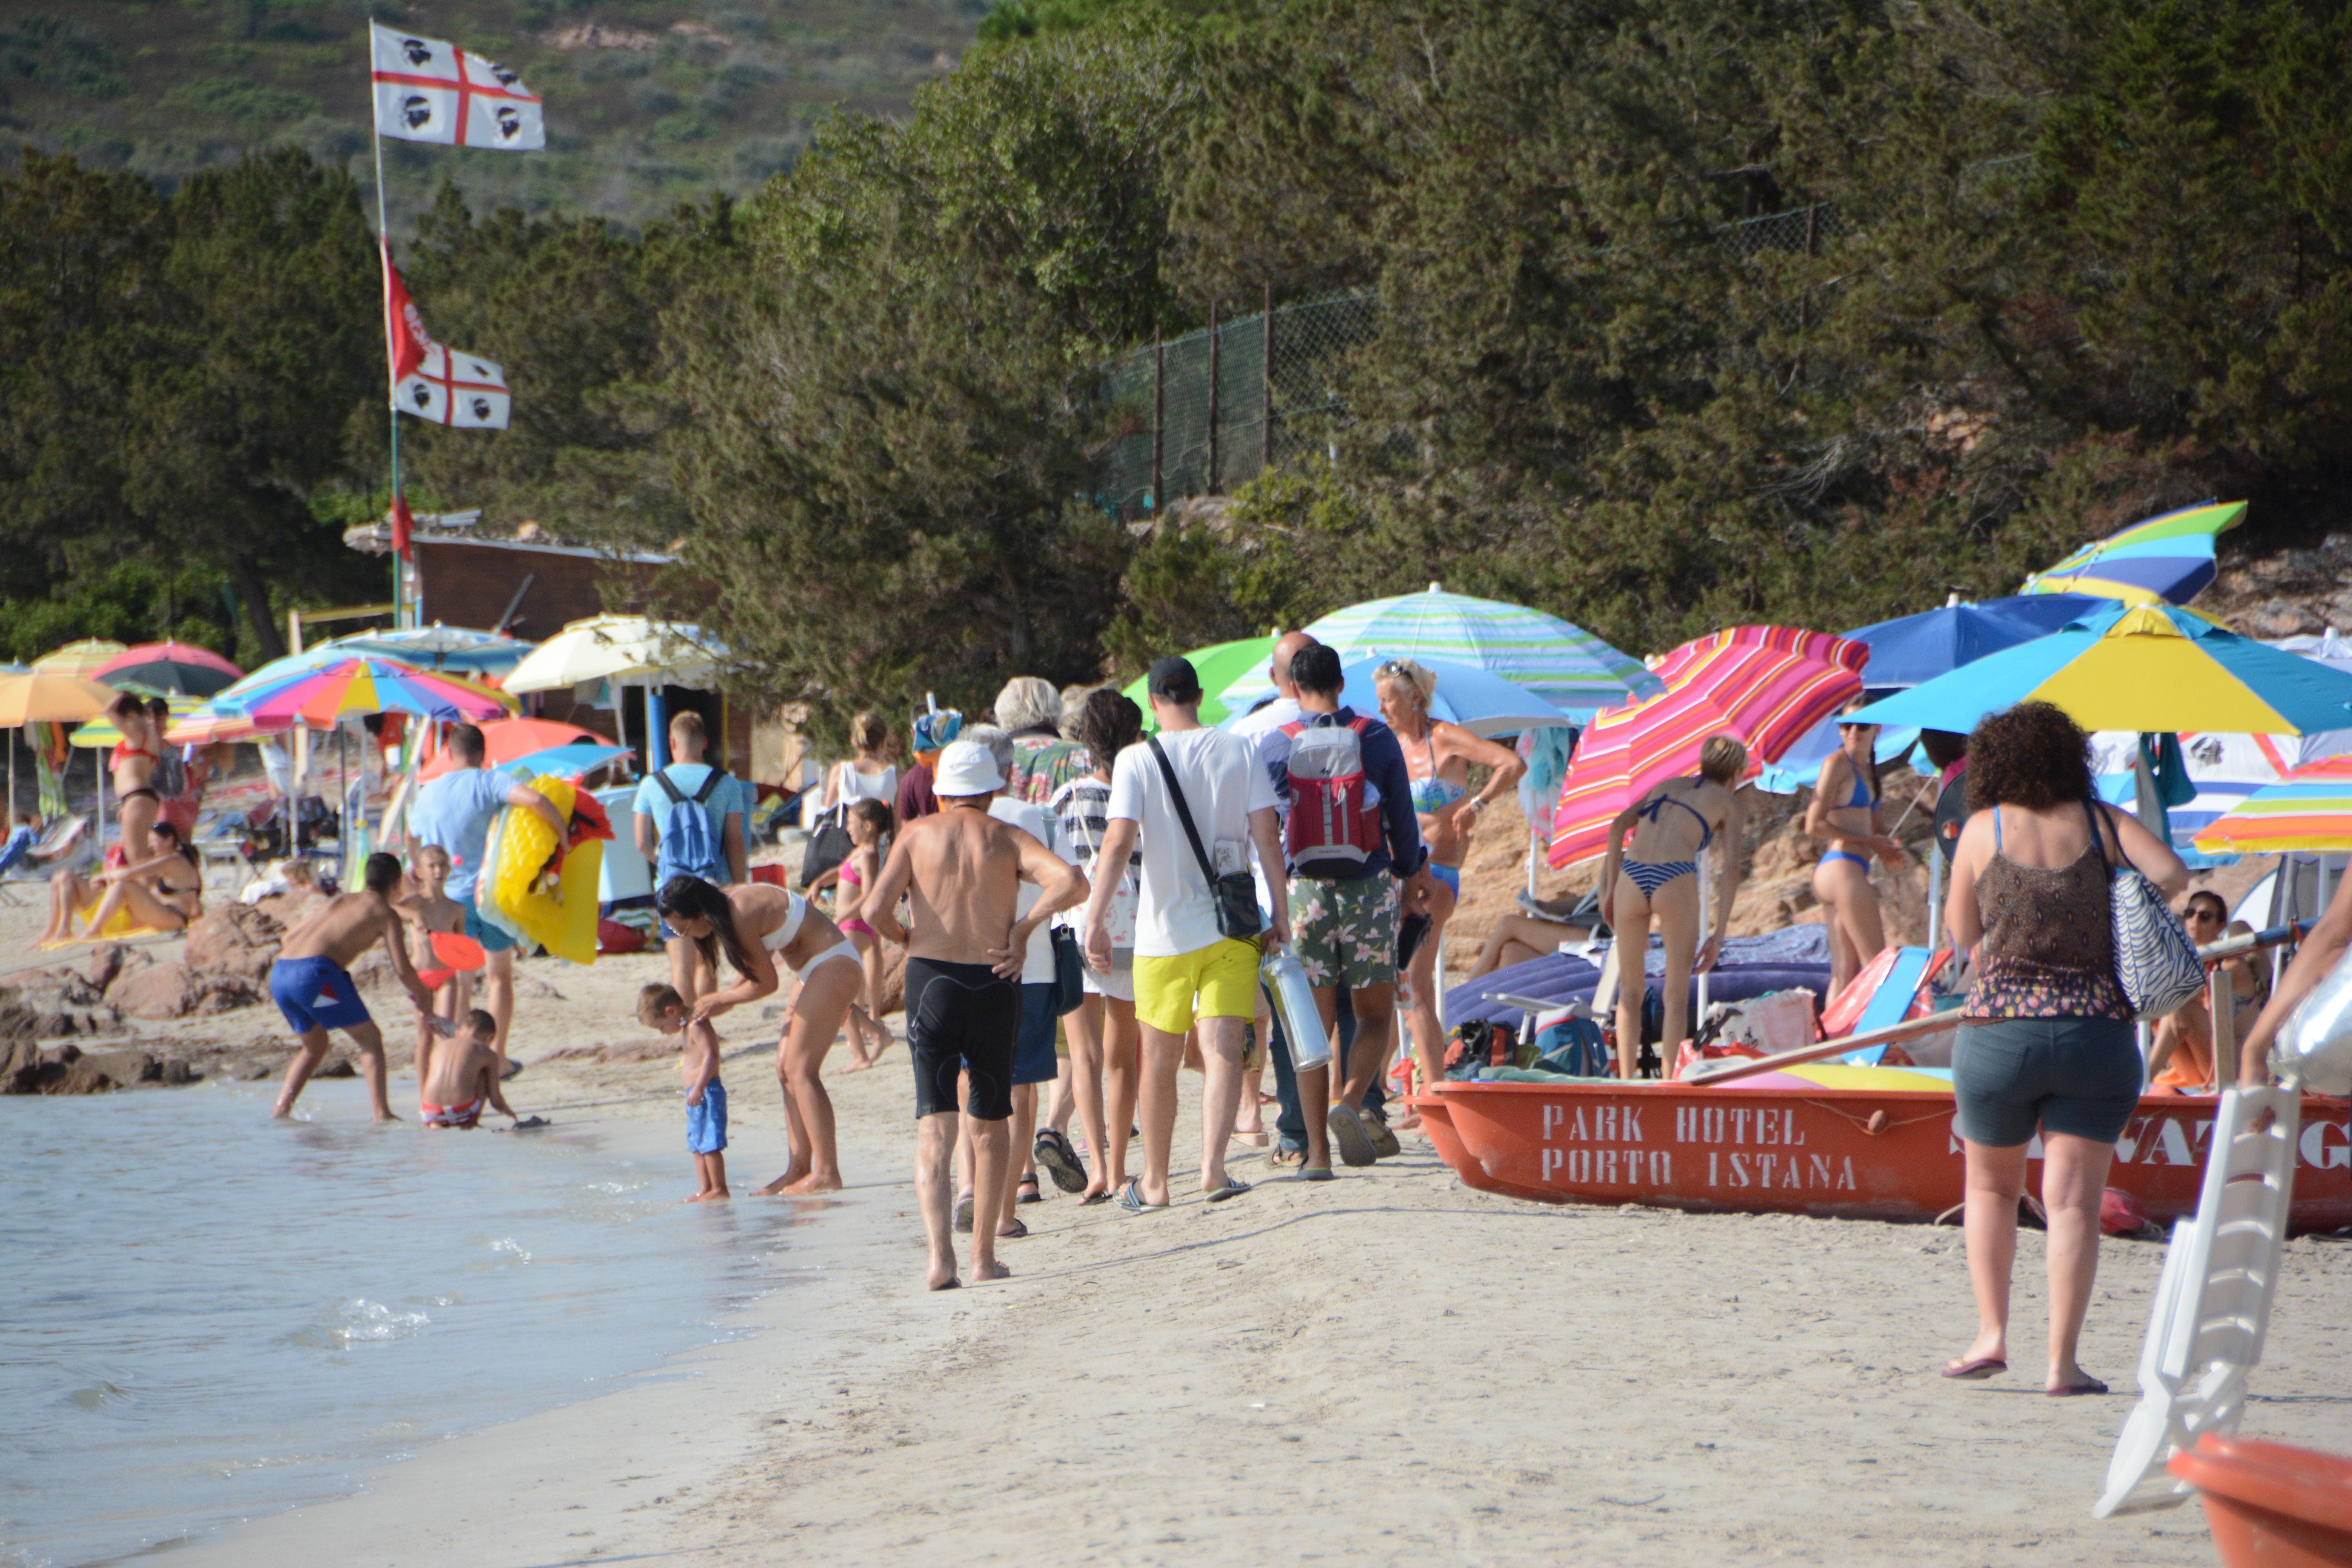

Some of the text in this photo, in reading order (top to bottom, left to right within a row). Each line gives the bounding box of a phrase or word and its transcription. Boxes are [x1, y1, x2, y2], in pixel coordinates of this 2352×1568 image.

[1543, 1105, 1804, 1145] PARK HOTEL
[1542, 1149, 1856, 1190] PORTO ISTANA
